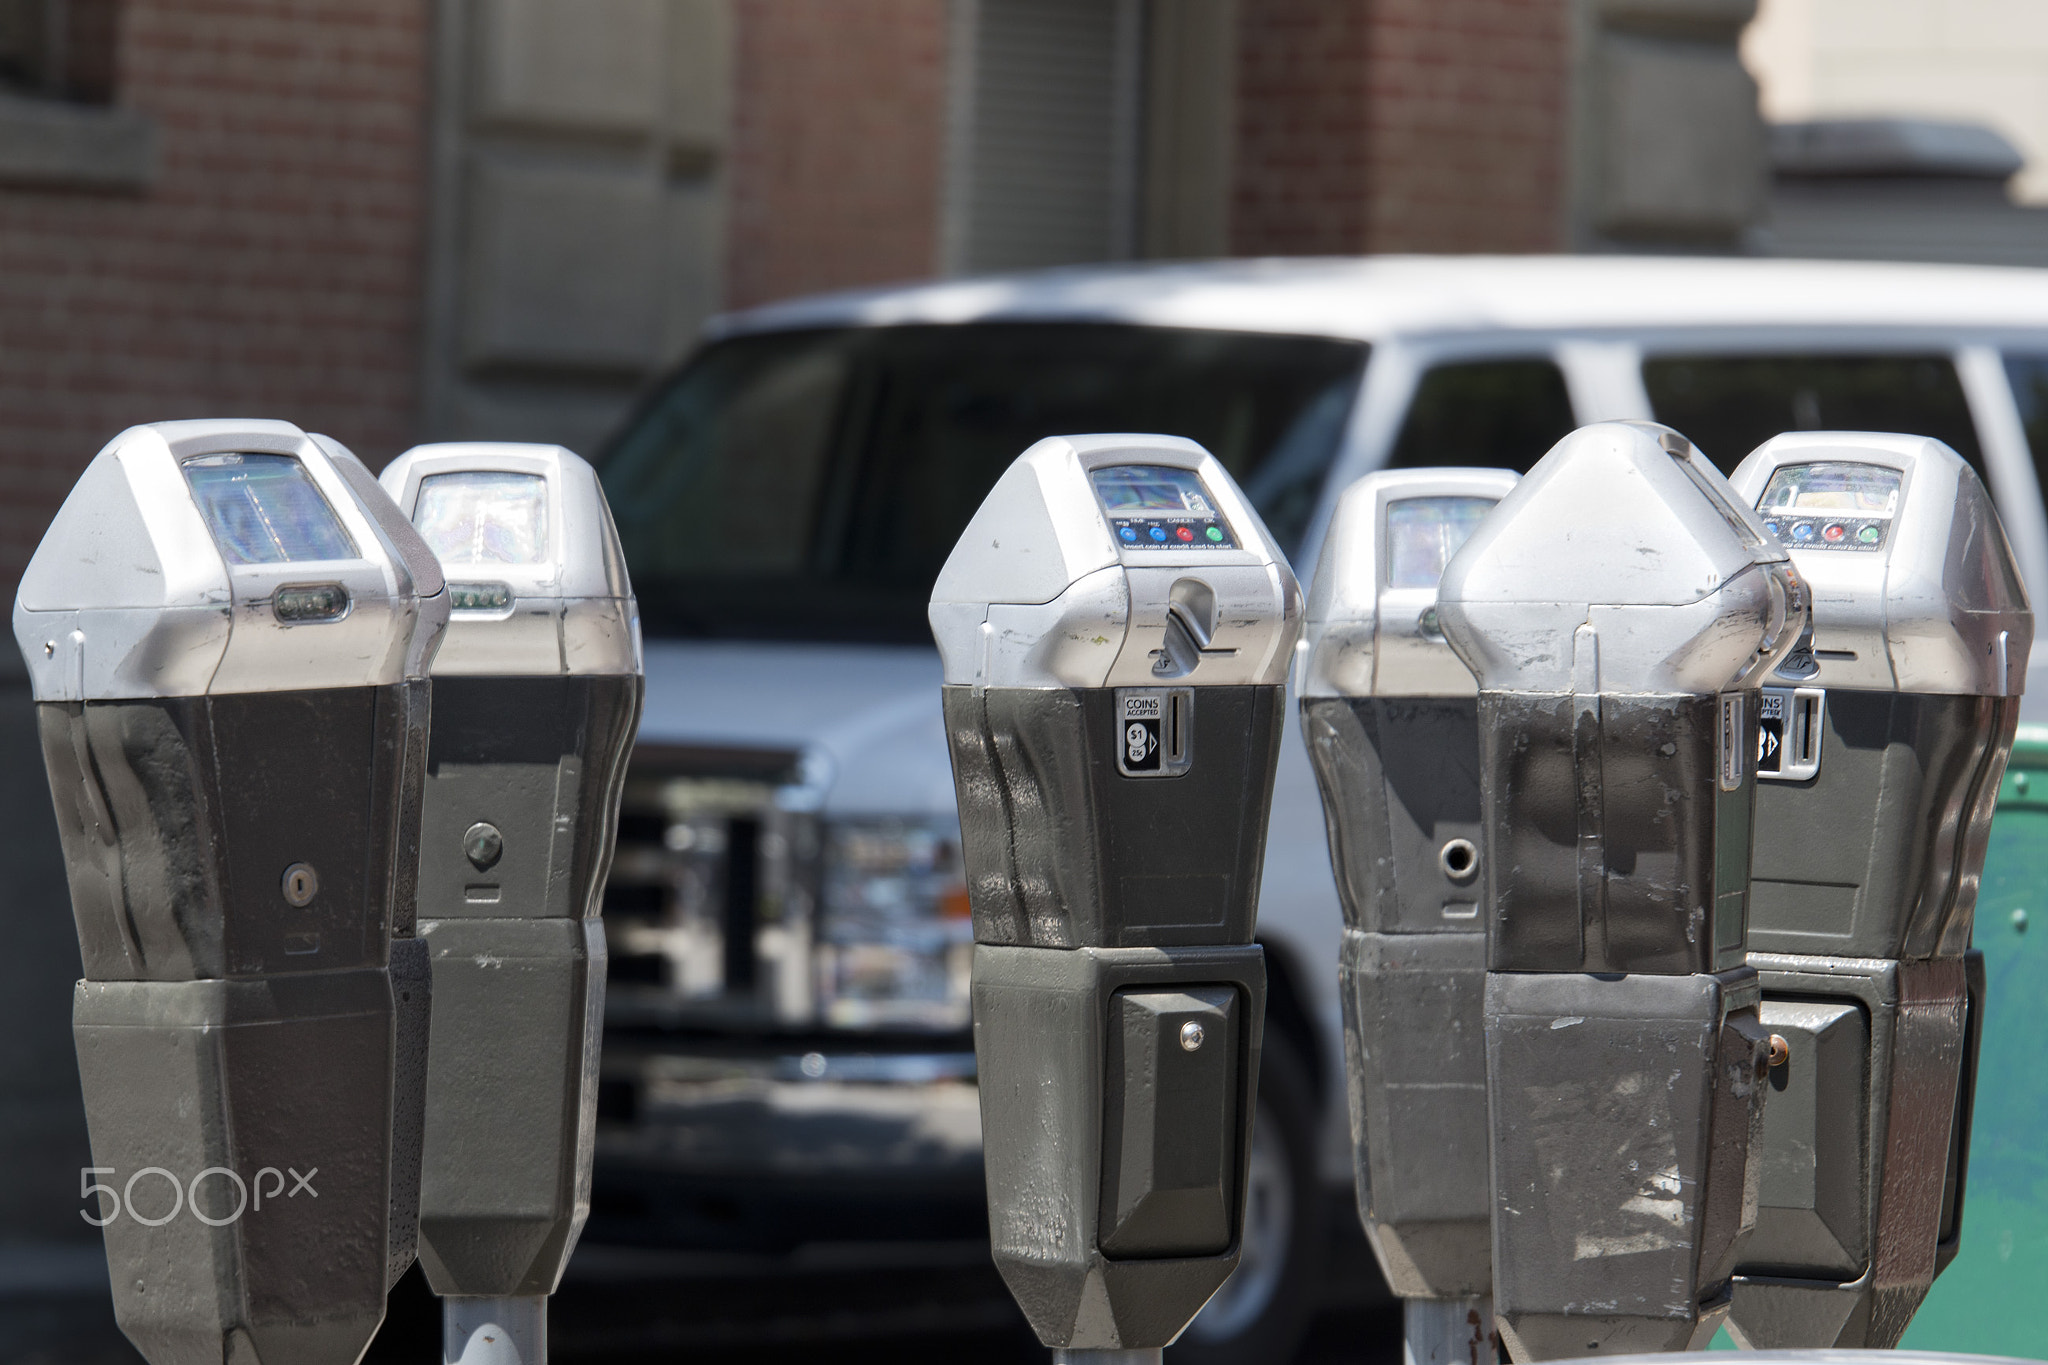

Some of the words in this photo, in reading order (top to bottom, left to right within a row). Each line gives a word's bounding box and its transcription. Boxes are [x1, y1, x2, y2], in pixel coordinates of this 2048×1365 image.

[1126, 699, 1158, 709] COINS
[1761, 698, 1780, 708] INS
[1131, 730, 1142, 740] $1
